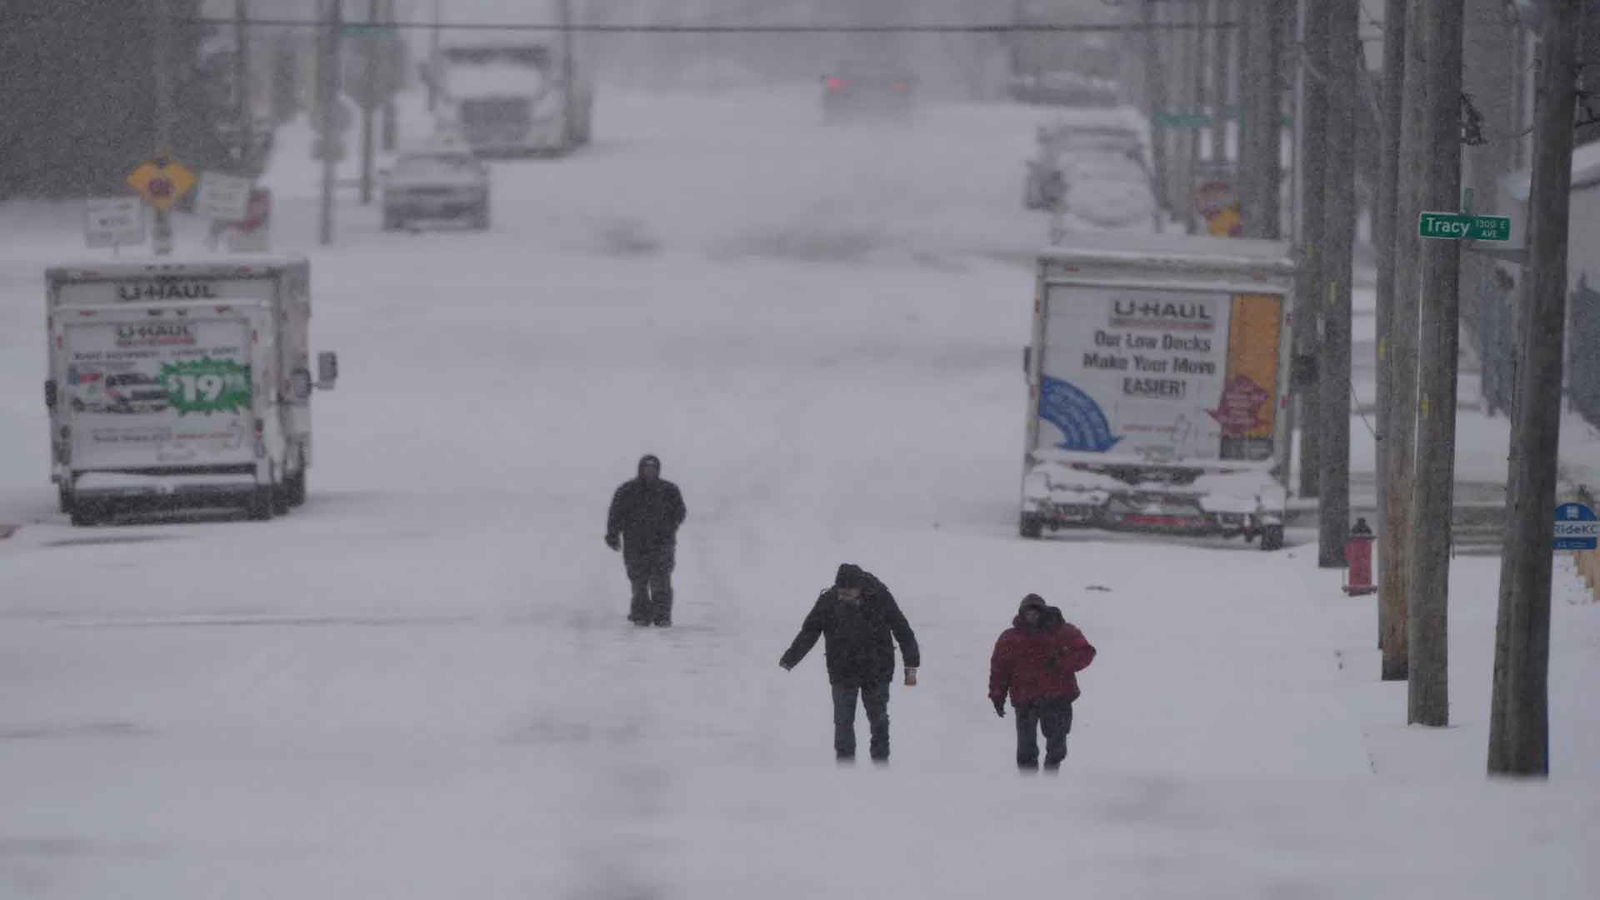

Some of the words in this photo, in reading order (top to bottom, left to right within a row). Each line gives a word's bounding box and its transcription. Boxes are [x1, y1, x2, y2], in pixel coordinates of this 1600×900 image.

[1426, 217, 1470, 236] Tracy
[1475, 219, 1496, 228] 1300
[1481, 230, 1498, 238] AVE
[120, 283, 216, 300] U-HAUL
[1114, 300, 1211, 319] U-HAUL
[1094, 329, 1121, 347] Our
[1126, 333, 1158, 349] Low
[1083, 353, 1128, 370] Make
[1133, 355, 1168, 373] Your
[1173, 356, 1216, 374] Move
[1123, 378, 1186, 396] EASIER!
